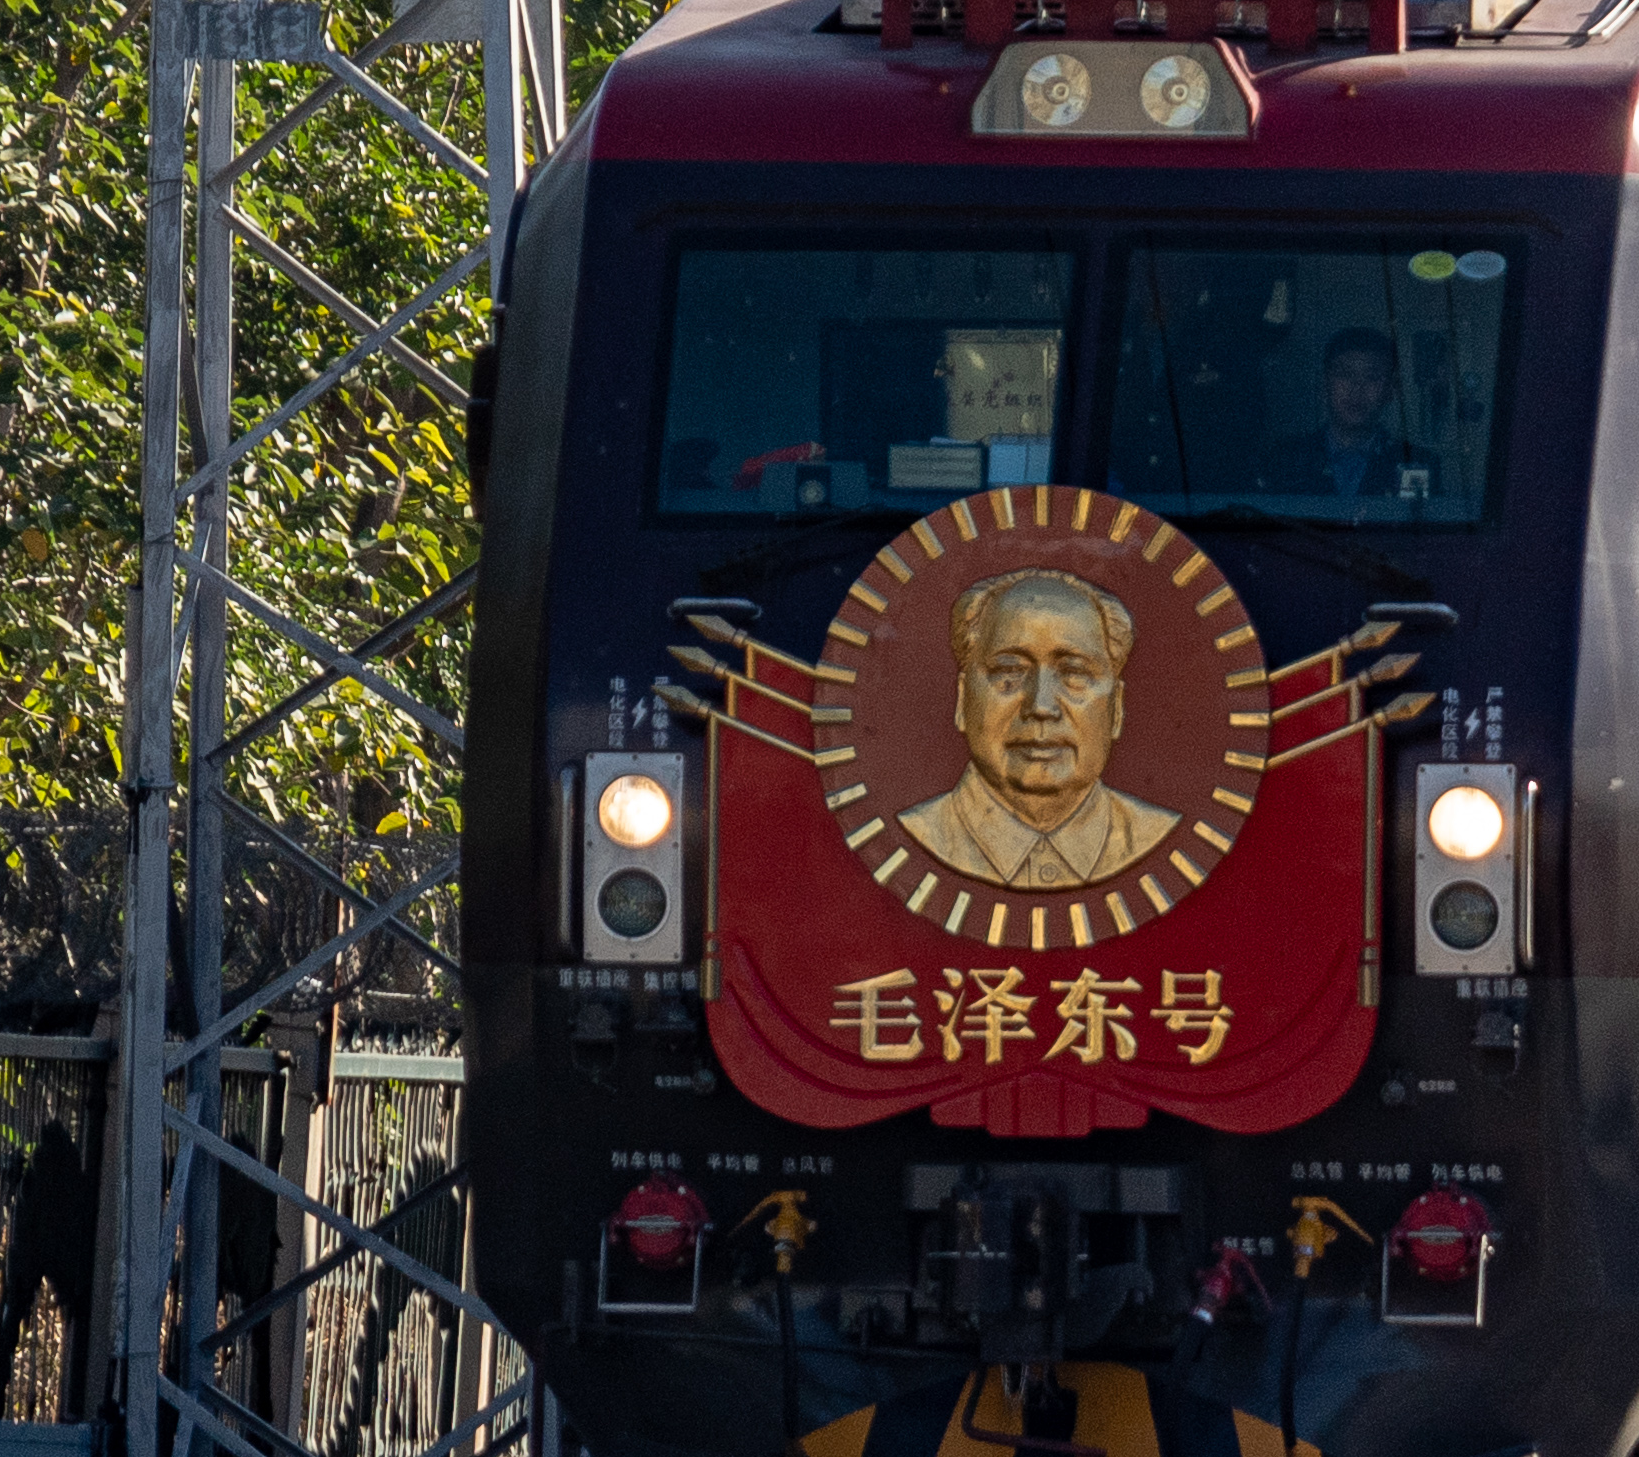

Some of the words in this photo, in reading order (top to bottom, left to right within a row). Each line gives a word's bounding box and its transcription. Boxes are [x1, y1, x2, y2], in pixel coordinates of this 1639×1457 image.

[608, 675, 626, 749] 电化区段
[1442, 687, 1459, 761] 电化区段
[828, 965, 1234, 1066] 毛泽东号
